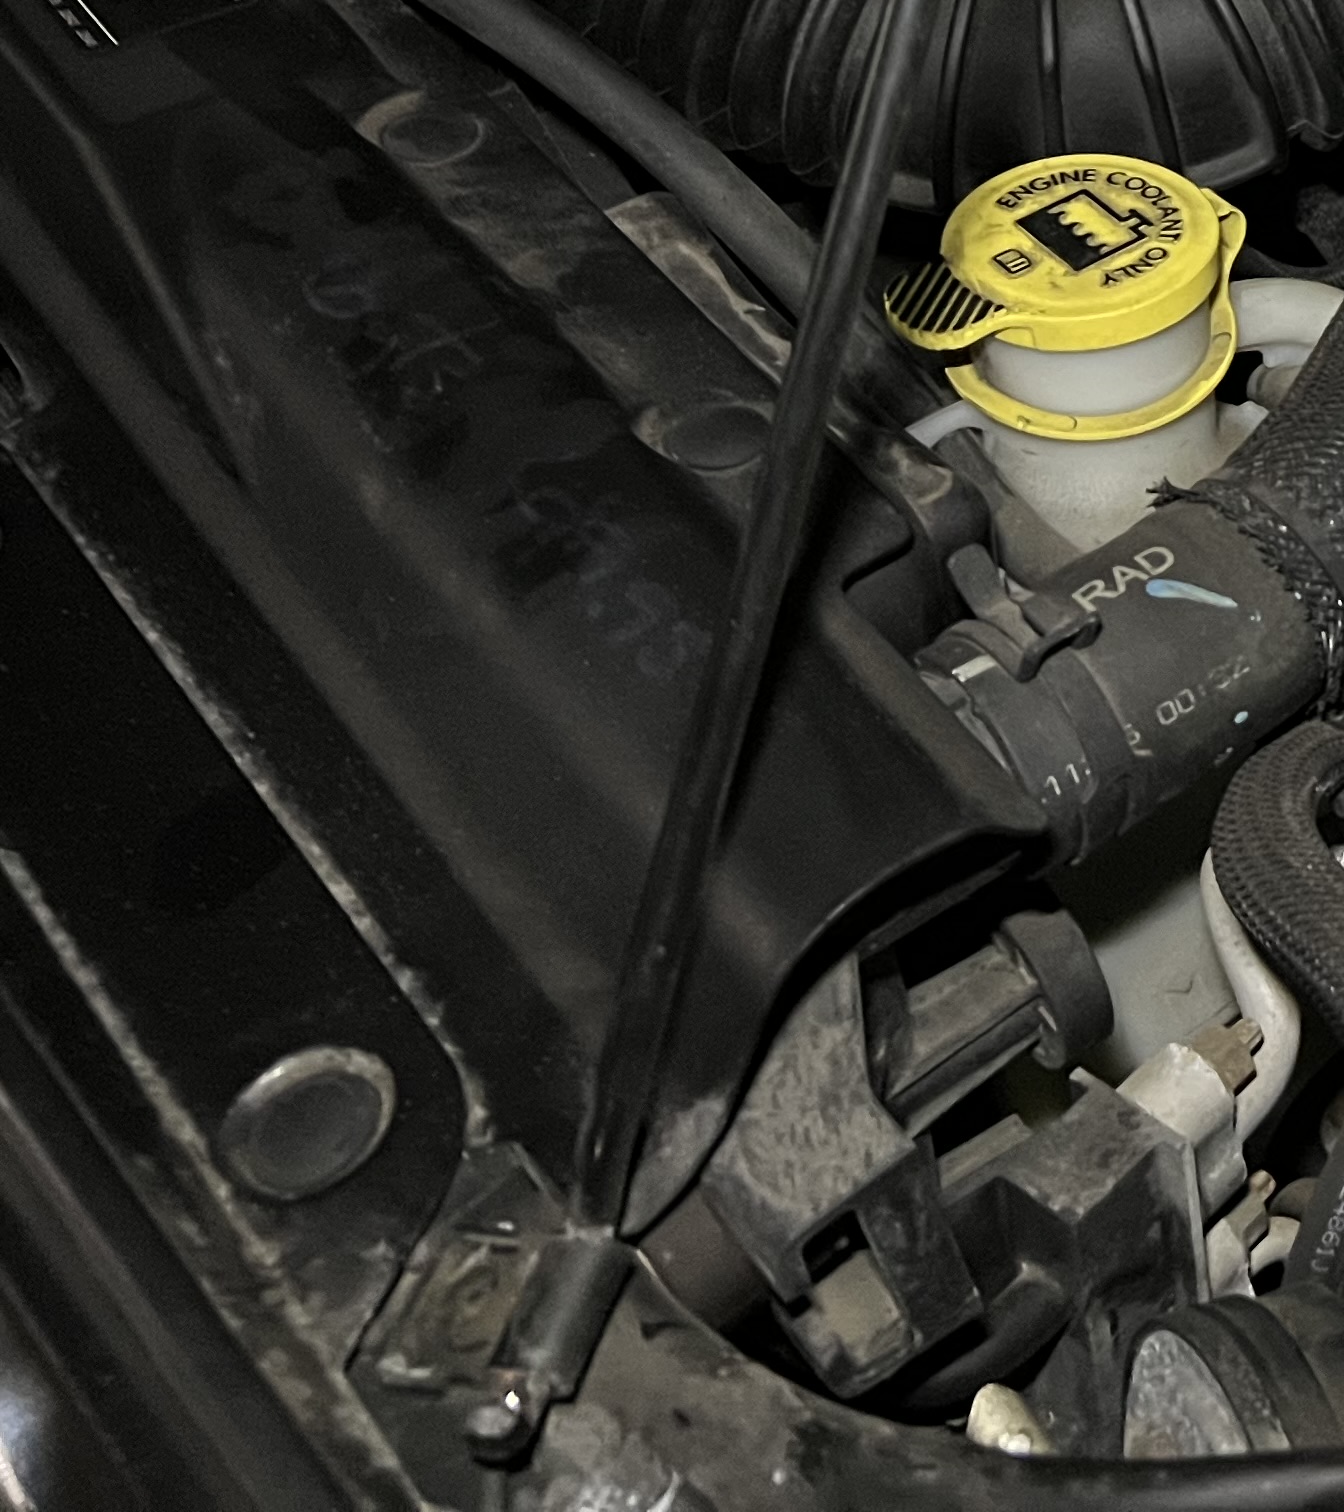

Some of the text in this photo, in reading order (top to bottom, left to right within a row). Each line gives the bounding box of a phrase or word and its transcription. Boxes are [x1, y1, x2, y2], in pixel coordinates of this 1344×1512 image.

[995, 168, 1185, 288] ENGINE COOLANT ONLY
[1072, 546, 1175, 613] RAD
